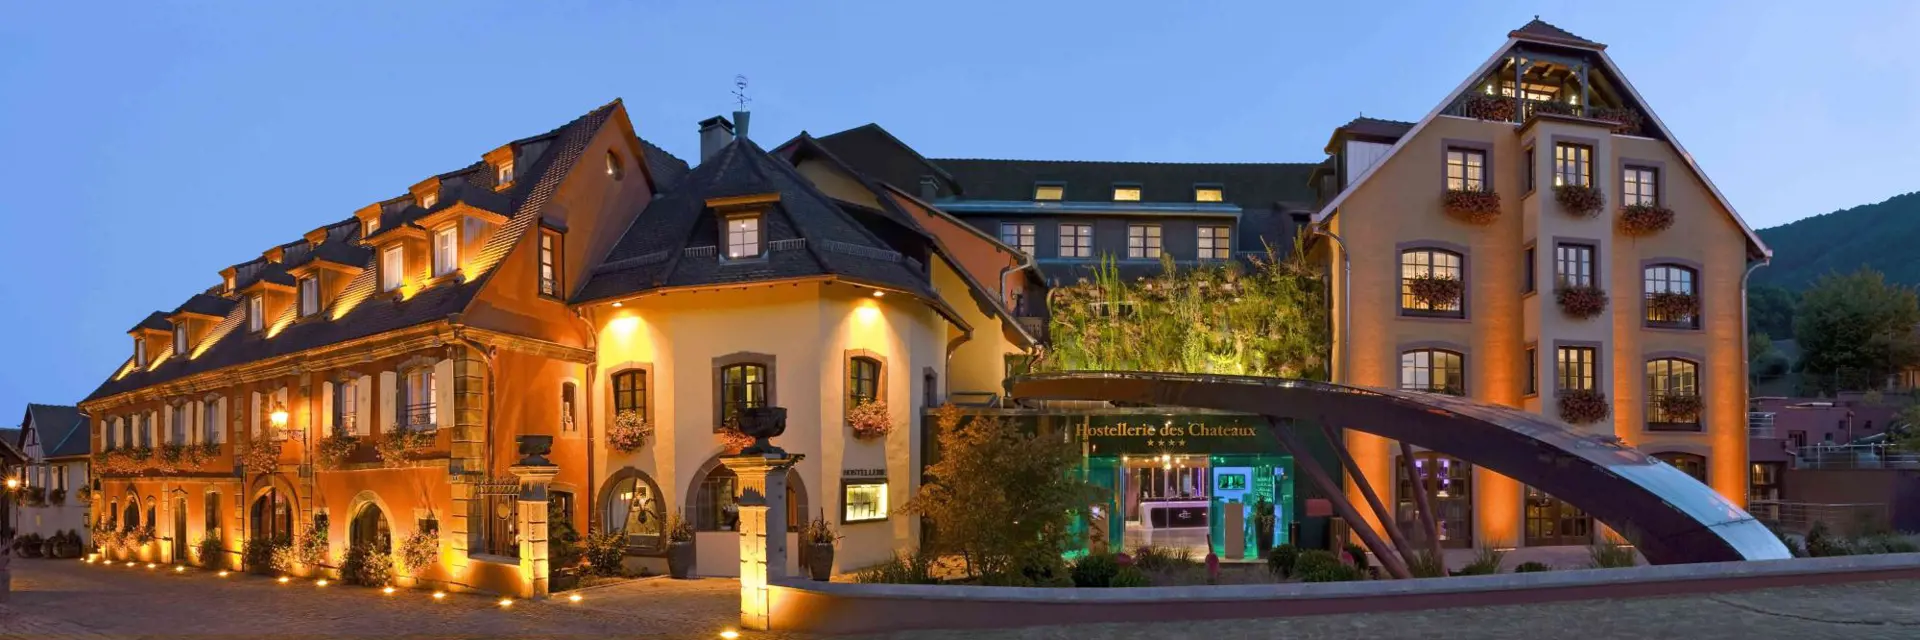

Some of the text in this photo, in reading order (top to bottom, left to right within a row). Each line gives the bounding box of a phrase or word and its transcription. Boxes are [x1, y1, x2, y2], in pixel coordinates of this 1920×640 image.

[1076, 422, 1257, 436] Hostellerie des Chateaux
